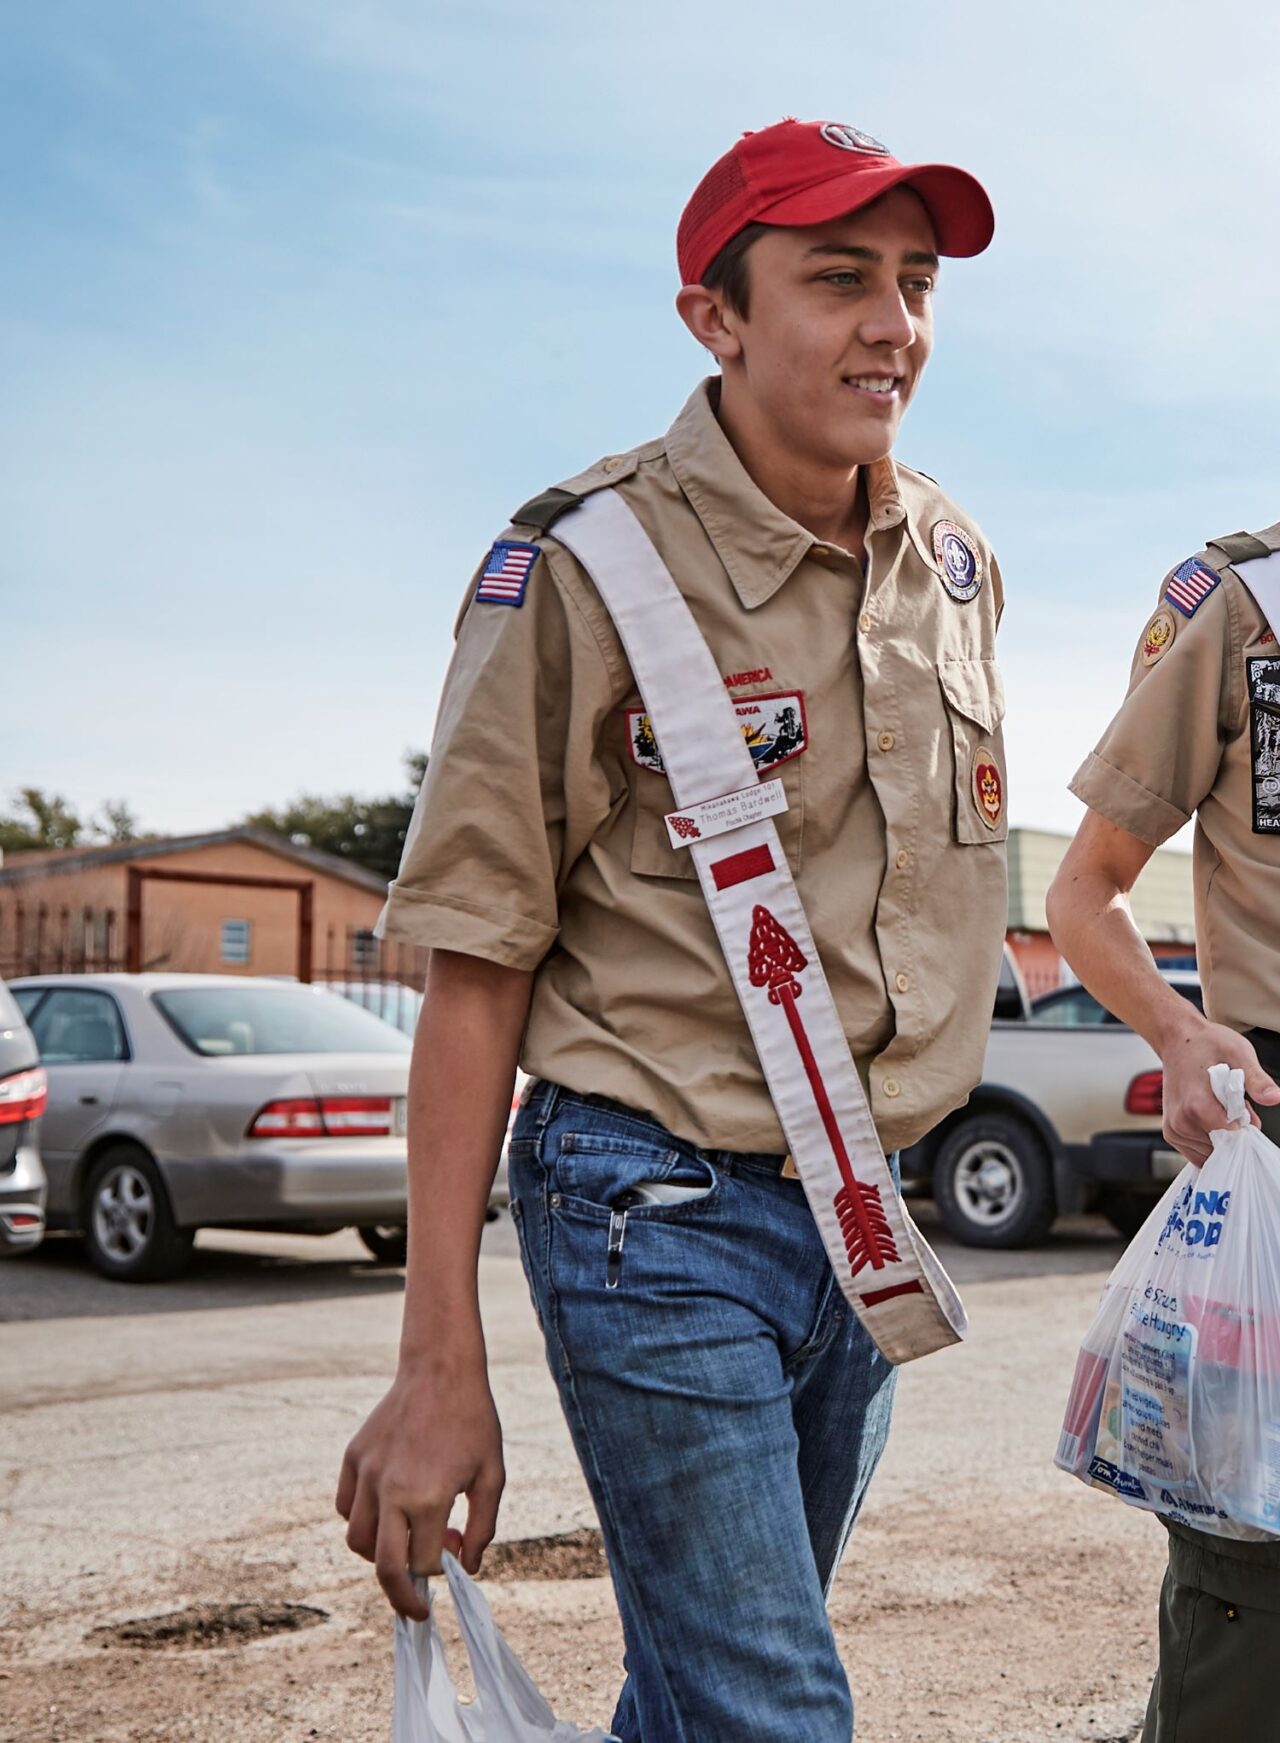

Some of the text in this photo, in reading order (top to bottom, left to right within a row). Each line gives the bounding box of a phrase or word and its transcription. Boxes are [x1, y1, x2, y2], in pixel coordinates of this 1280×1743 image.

[699, 790, 783, 824] Thomas Bardwell
[1093, 1459, 1113, 1480] Tom
